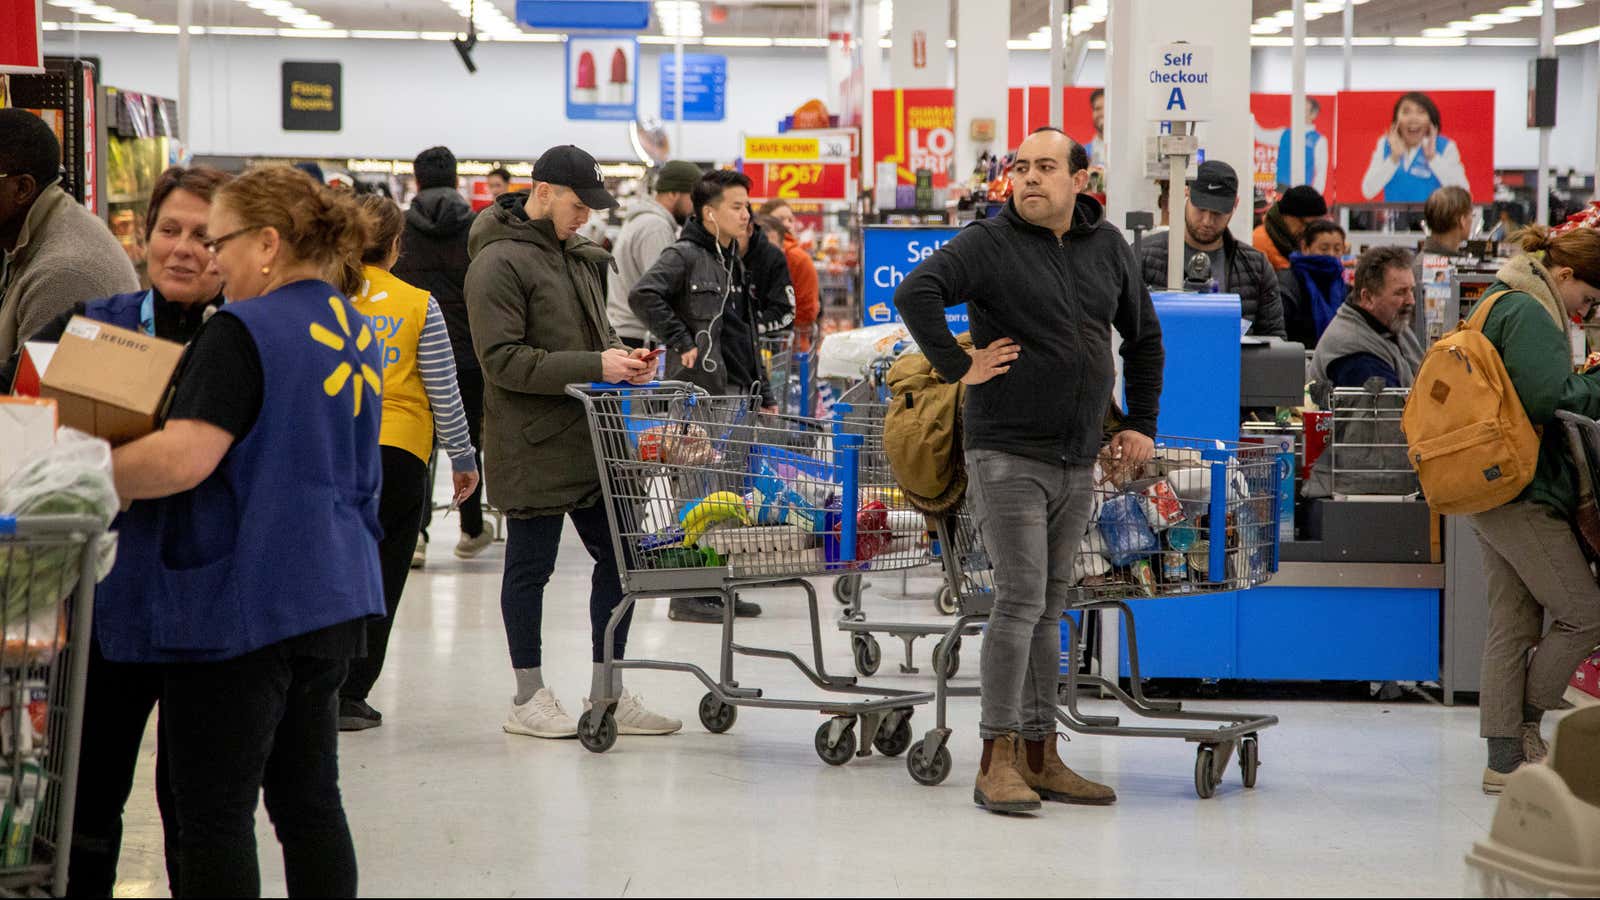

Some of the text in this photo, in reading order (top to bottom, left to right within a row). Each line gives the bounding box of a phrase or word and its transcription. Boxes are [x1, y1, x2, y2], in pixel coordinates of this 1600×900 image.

[1164, 52, 1193, 67] Self
[1149, 69, 1208, 84] Checkout
[1166, 87, 1186, 111] A
[100, 332, 151, 352] KEURIG
